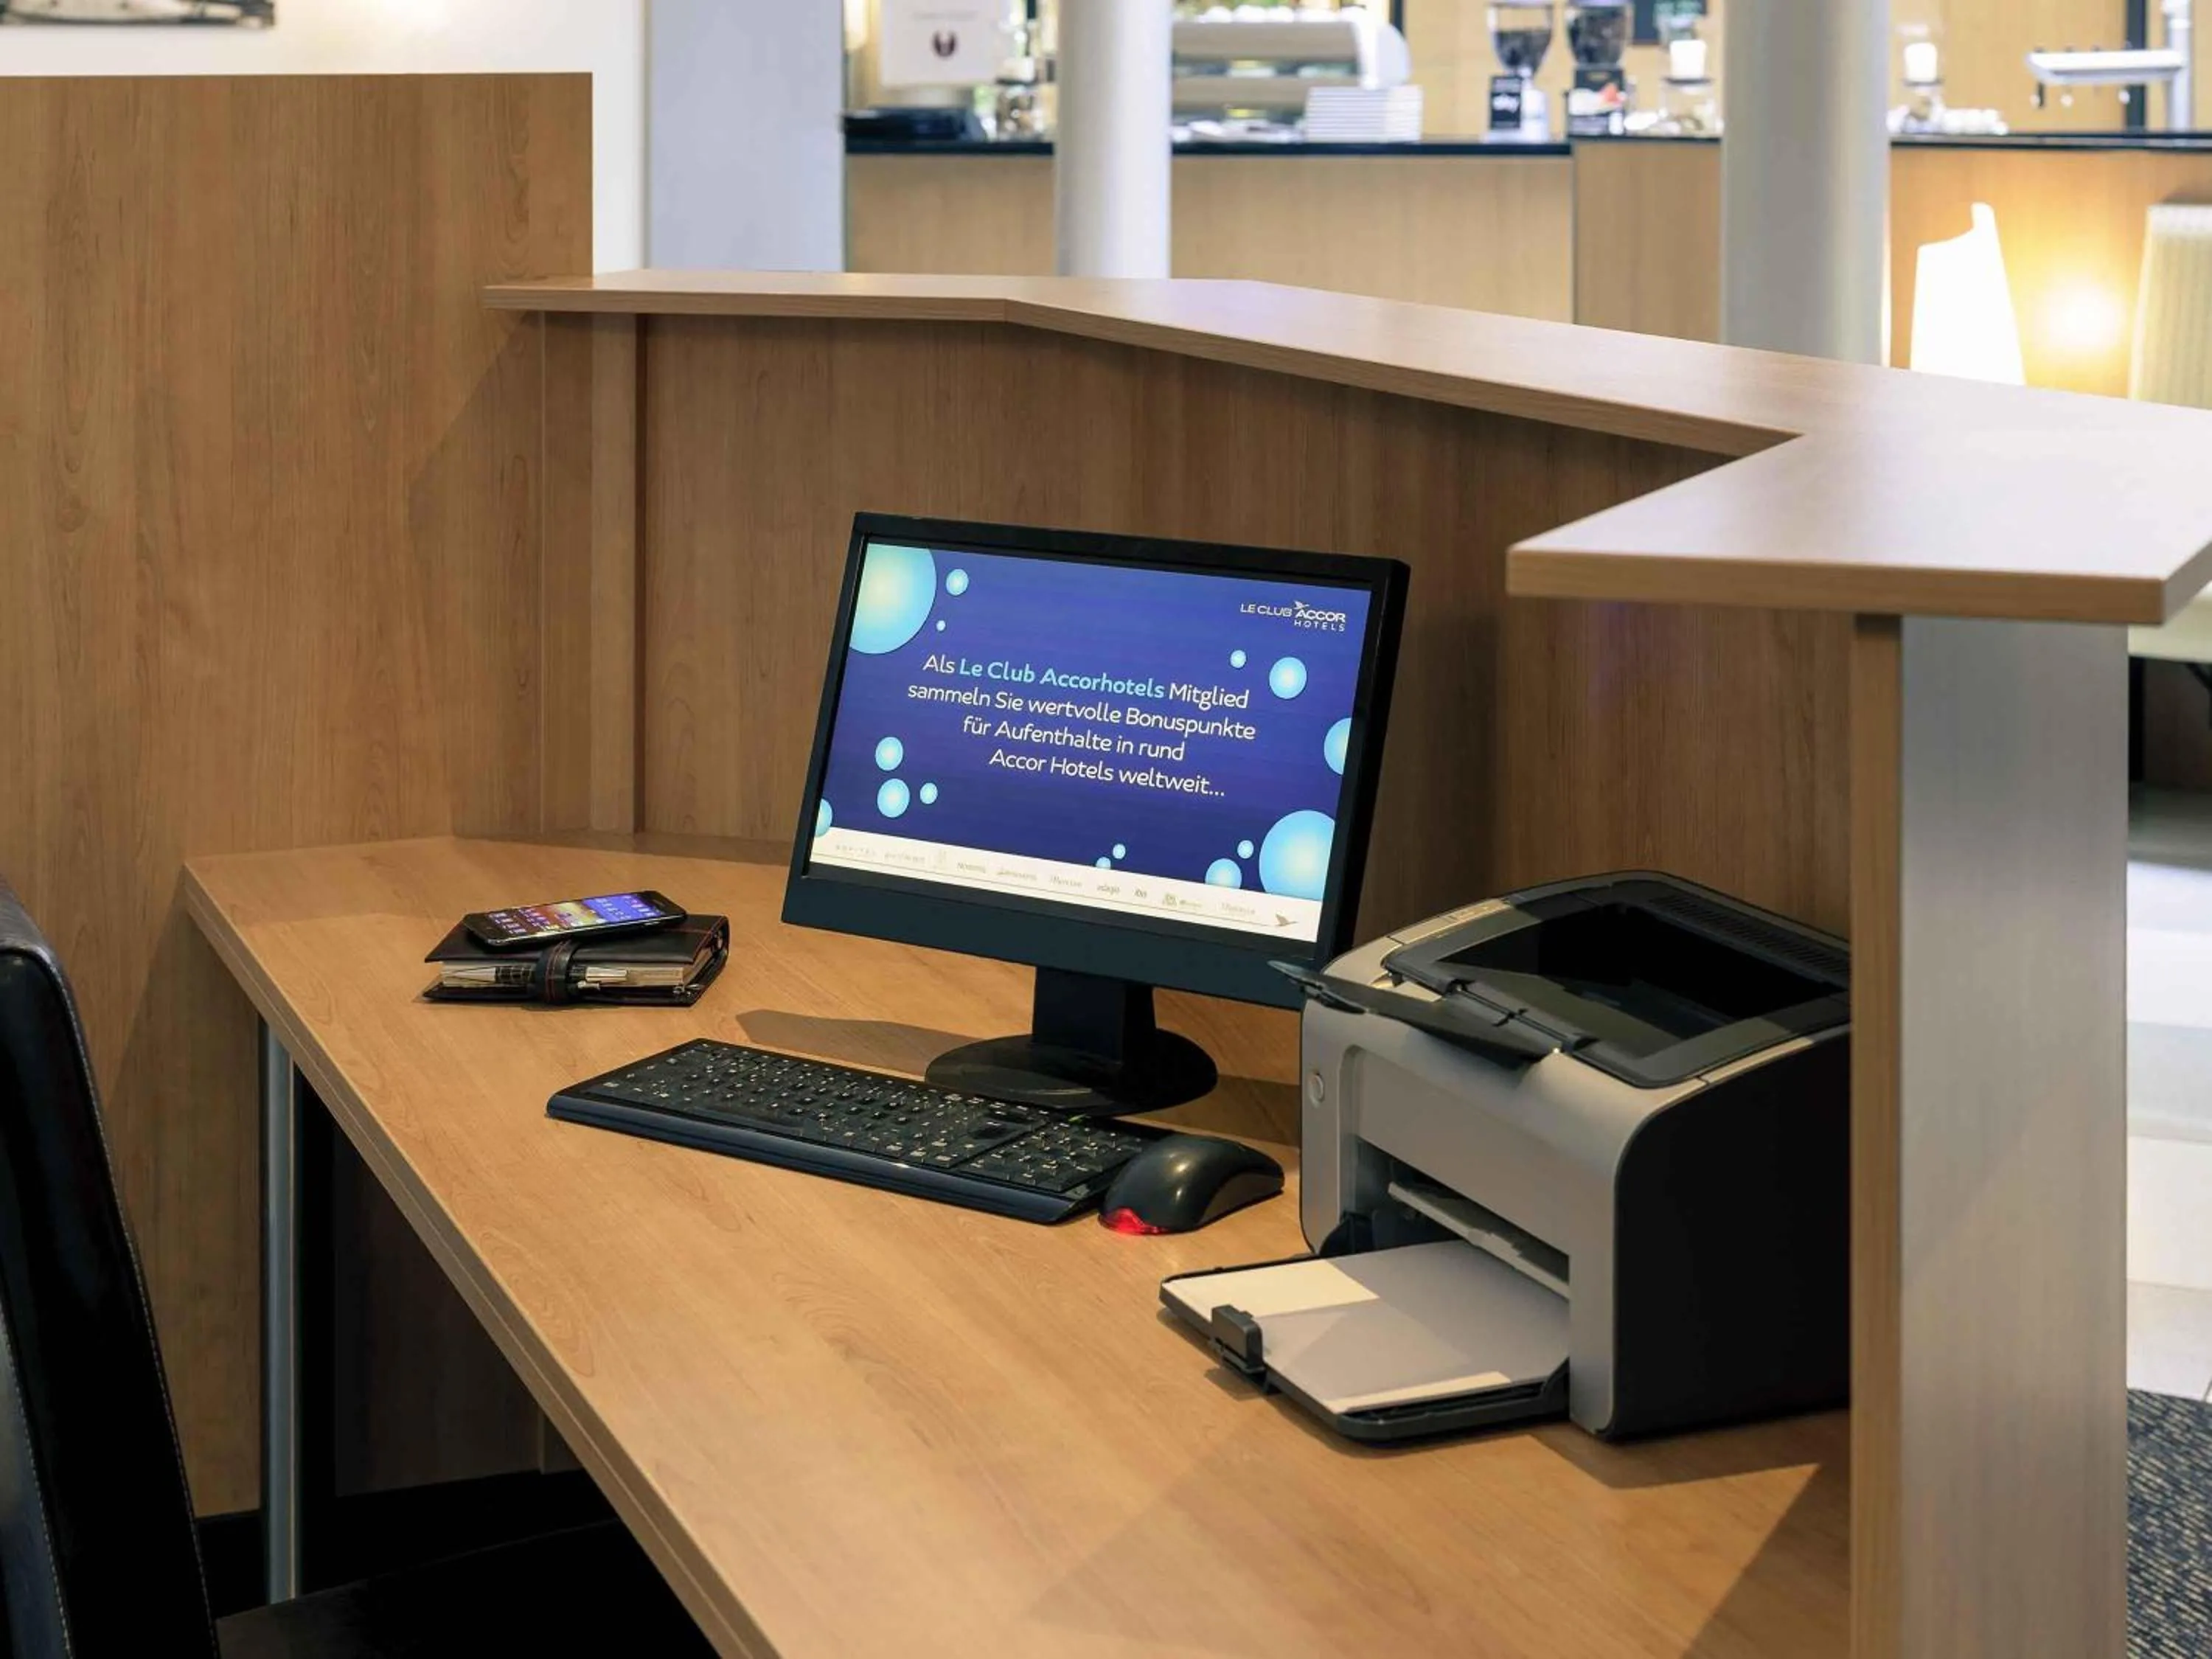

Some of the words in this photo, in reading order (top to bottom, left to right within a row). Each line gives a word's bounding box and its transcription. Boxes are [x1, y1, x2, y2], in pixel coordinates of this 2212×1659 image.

[1239, 603, 1256, 613] LE
[1257, 605, 1293, 618] CLUB
[1295, 609, 1346, 623] ACCOR
[1293, 619, 1346, 633] HOTELS
[922, 654, 956, 675] Als
[959, 658, 984, 678] Le
[987, 661, 1036, 684] Club
[1039, 667, 1166, 699] Accorhotels
[1168, 682, 1250, 712] Mitglied
[907, 684, 991, 707] sammeln
[994, 690, 1024, 712] Sie
[1027, 698, 1122, 724] wertvolle
[1124, 706, 1256, 740] Bonuspunkte
[963, 714, 992, 736] für
[994, 720, 1113, 753] Aufenthalte
[1116, 734, 1135, 755] in
[1138, 740, 1186, 762] rund
[988, 748, 1048, 772] Accor
[1050, 756, 1114, 782] Hotels
